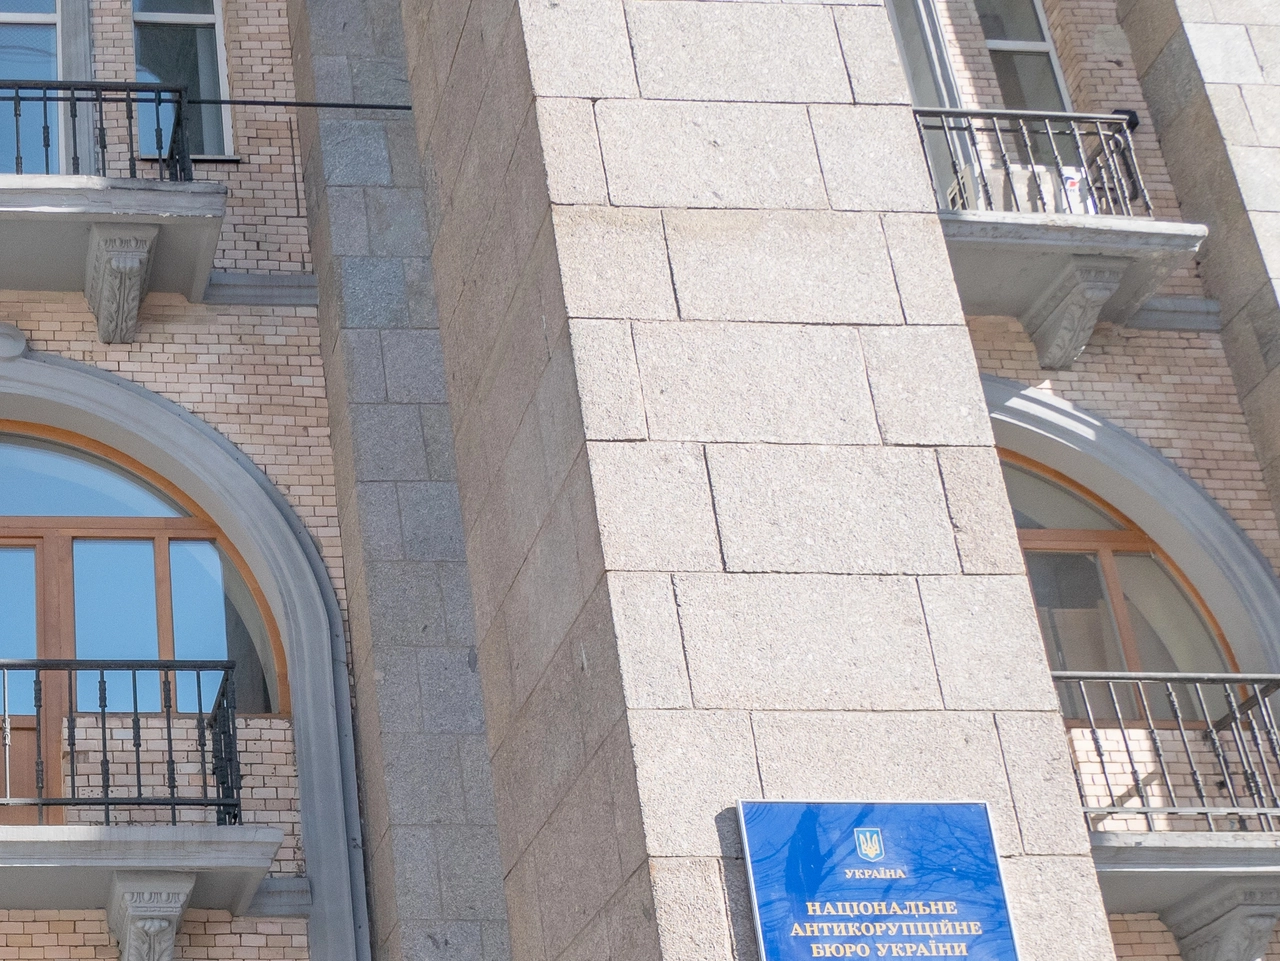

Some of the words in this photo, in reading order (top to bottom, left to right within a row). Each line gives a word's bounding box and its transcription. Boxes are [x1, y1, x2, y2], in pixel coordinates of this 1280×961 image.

[845, 868, 906, 879] УКРАЇНА
[806, 901, 958, 917] НАЦІОНАЛЬНЕ
[790, 920, 982, 937] АНТИКОРУПЦІЙНЕ
[810, 943, 871, 958] БЮРО
[876, 941, 968, 957] УКРАЇНИ
